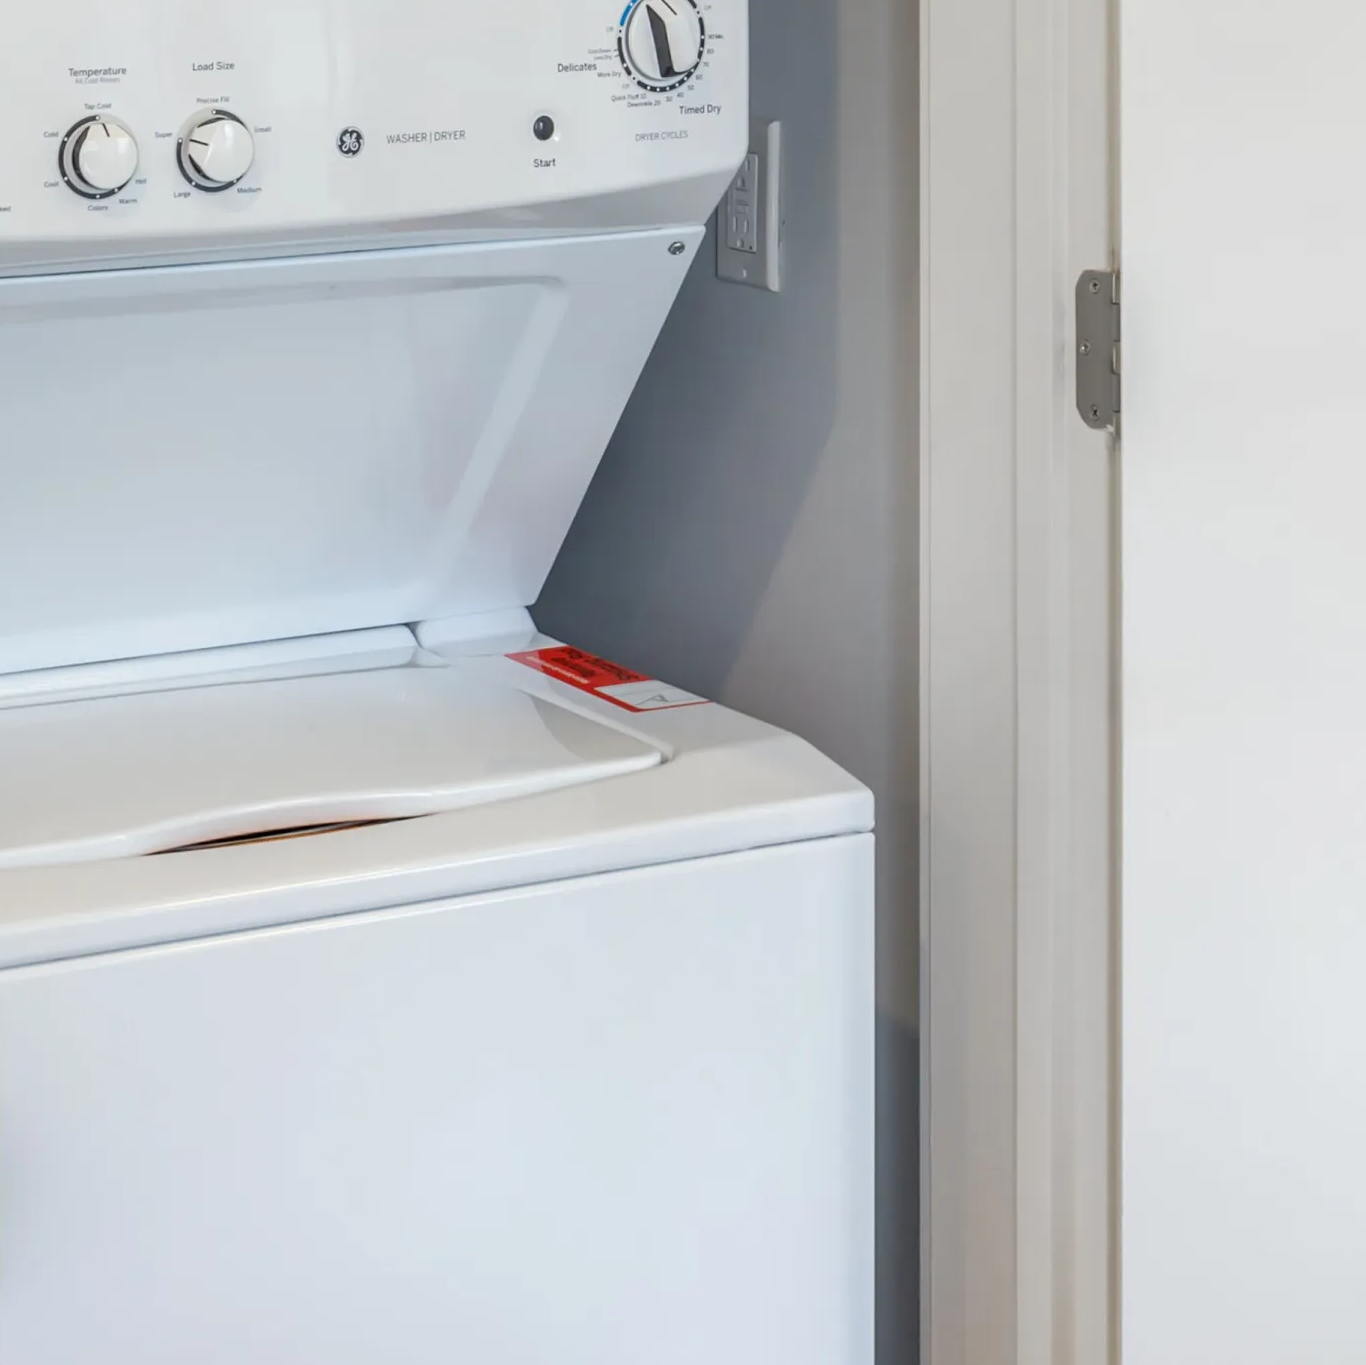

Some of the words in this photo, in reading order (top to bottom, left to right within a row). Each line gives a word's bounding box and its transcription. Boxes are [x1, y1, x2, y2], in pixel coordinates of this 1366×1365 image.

[193, 62, 214, 71] Load
[216, 61, 235, 70] Size
[557, 63, 597, 72] Delicates
[69, 67, 127, 77] Temperature
[679, 106, 705, 115] Timed
[707, 104, 721, 114] Dry
[386, 132, 427, 144] WASHER
[435, 130, 466, 141] DRYER
[635, 133, 659, 142] DRYER
[661, 130, 689, 140] CYCLES
[534, 159, 556, 167] Start
